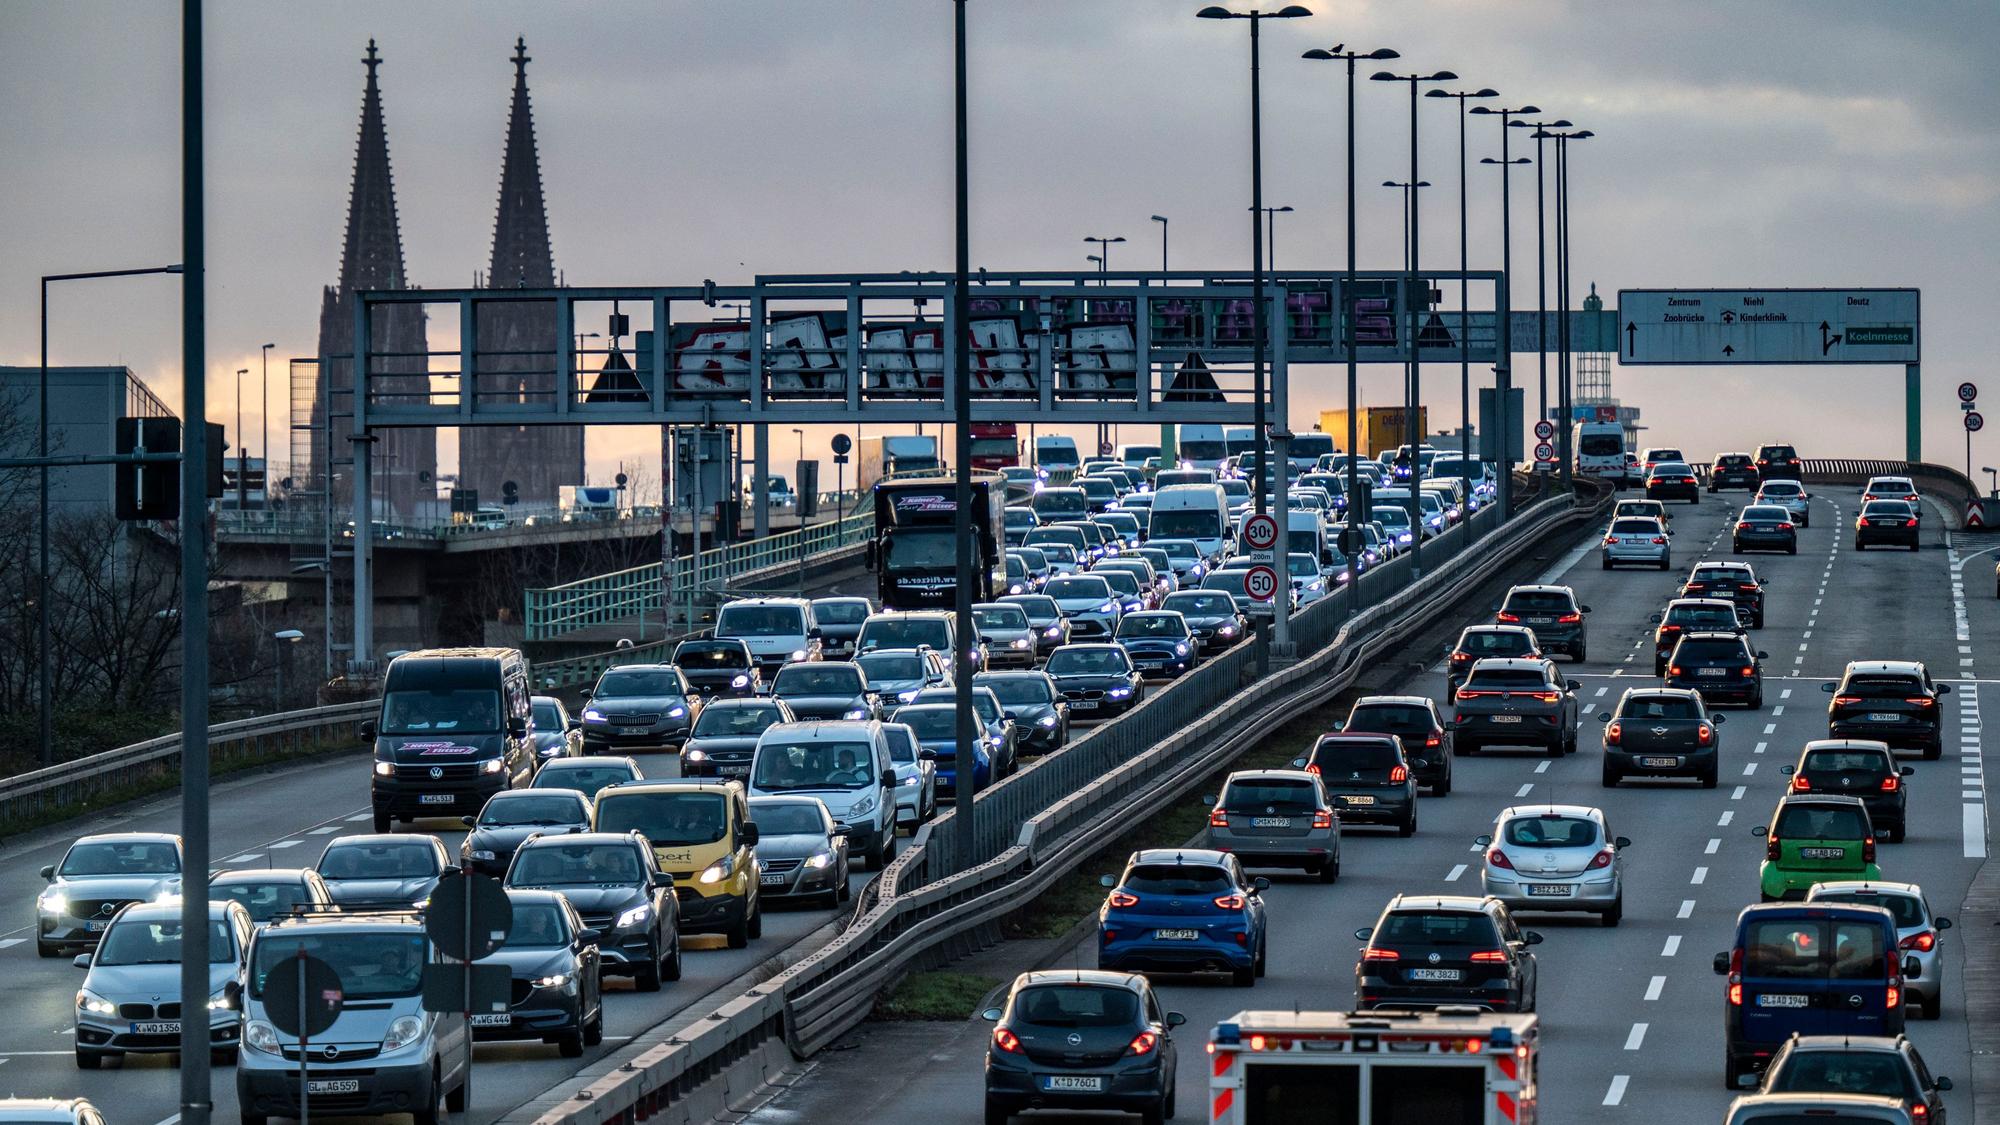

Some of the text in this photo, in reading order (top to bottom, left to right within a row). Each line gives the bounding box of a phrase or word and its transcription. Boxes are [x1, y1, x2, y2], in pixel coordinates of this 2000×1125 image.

[1668, 297, 1701, 306] Zentrum
[1743, 297, 1764, 306] Niehl
[1847, 297, 1870, 306] Deutz
[1663, 313, 1705, 322] Zoobrücke
[1739, 313, 1788, 322] Kinderklinik
[1849, 331, 1909, 341] Koelnmesse
[1962, 387, 1973, 397] 50
[1537, 426, 1551, 434] 30t
[1538, 448, 1550, 457] 50
[1250, 525, 1272, 539] 30t
[1252, 576, 1271, 592] 50
[1180, 930, 1194, 938] 913
[1437, 971, 1457, 979] 3823
[1762, 995, 1771, 1004] GL
[1788, 996, 1808, 1005] 1944
[481, 1015, 492, 1023] WG
[494, 1015, 509, 1023] 444
[159, 1024, 180, 1032] 1356
[309, 1081, 357, 1092] GL AG 559
[1074, 1078, 1096, 1087] 7601
